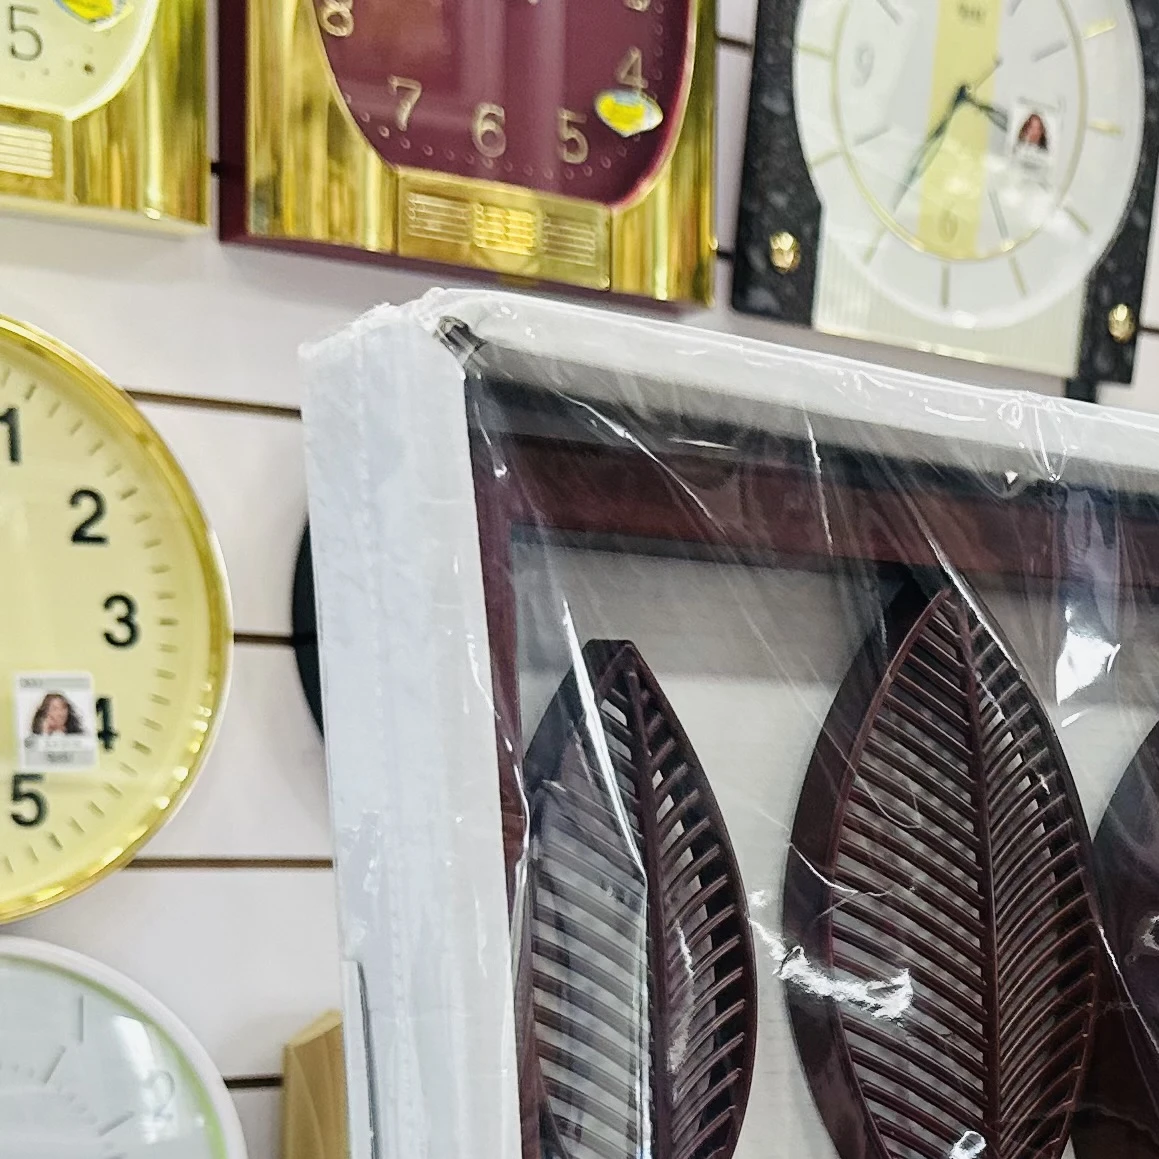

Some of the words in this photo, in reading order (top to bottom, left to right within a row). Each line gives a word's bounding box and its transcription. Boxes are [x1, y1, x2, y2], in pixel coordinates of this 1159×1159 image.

[9, 4, 42, 61] 5
[387, 74, 422, 131] 7
[471, 102, 507, 158] 6
[558, 106, 589, 165] 5
[0, 406, 21, 463] 1
[68, 488, 108, 545] 2
[102, 594, 140, 649] 3
[9, 772, 48, 827] 5
